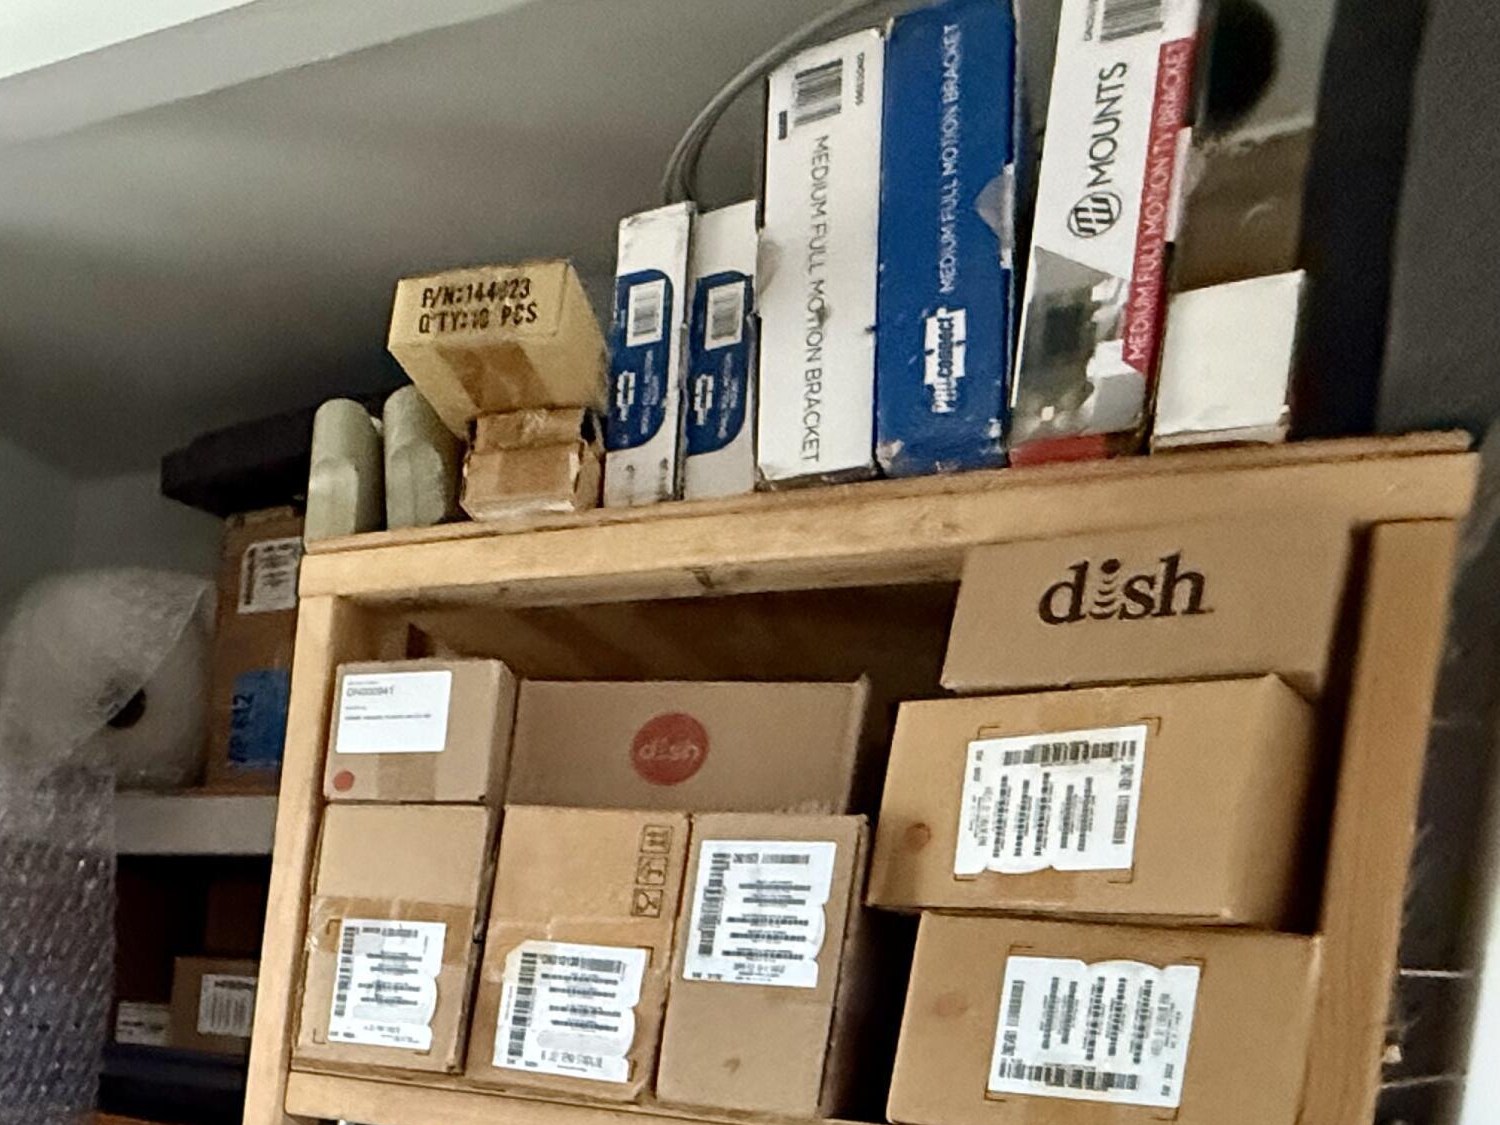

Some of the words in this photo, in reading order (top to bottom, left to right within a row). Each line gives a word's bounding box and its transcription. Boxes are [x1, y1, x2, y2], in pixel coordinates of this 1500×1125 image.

[941, 106, 960, 176] MOTION
[1087, 62, 1128, 188] MOUNTS
[811, 135, 830, 222] MEDIUM
[941, 179, 959, 221] FULL
[1143, 156, 1170, 236] MOTION
[808, 224, 828, 275] FULL
[939, 225, 955, 293] MEDIUM
[1136, 245, 1161, 285] FULL
[500, 302, 538, 326] PCS
[806, 280, 825, 363] MOTION
[1128, 287, 1155, 360] MEDIUM
[801, 367, 823, 462] BRACKET
[1038, 549, 1213, 625] dish
